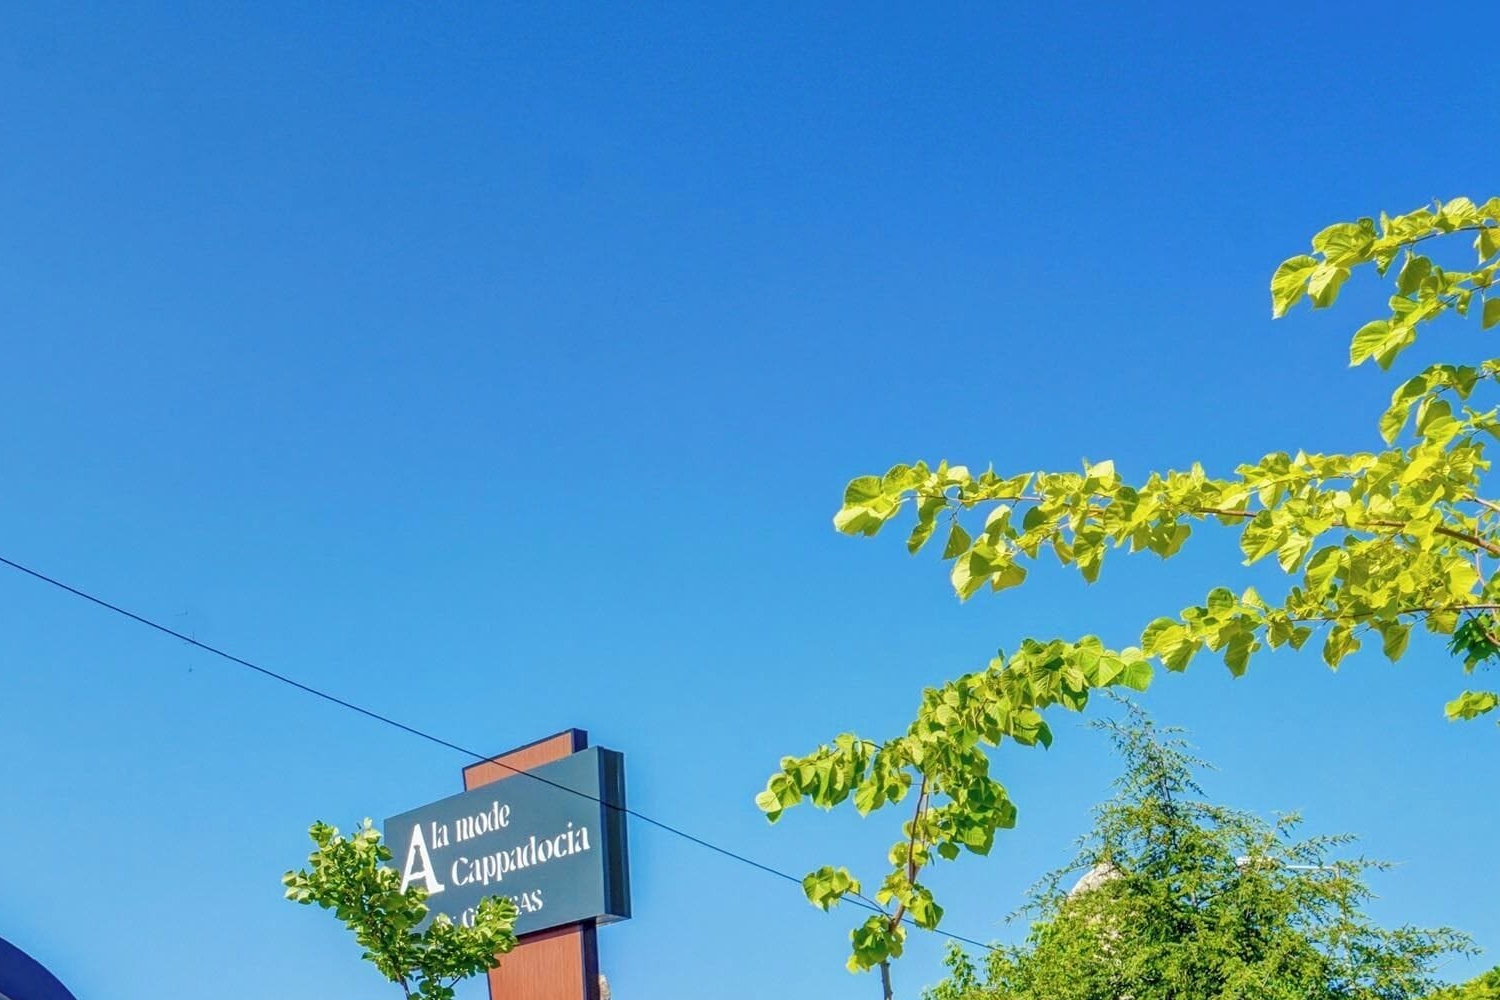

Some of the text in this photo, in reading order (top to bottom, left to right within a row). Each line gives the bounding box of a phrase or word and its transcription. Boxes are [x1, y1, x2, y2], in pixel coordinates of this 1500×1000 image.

[400, 801, 510, 896] A la mode
[452, 821, 591, 886] Cappadocia
